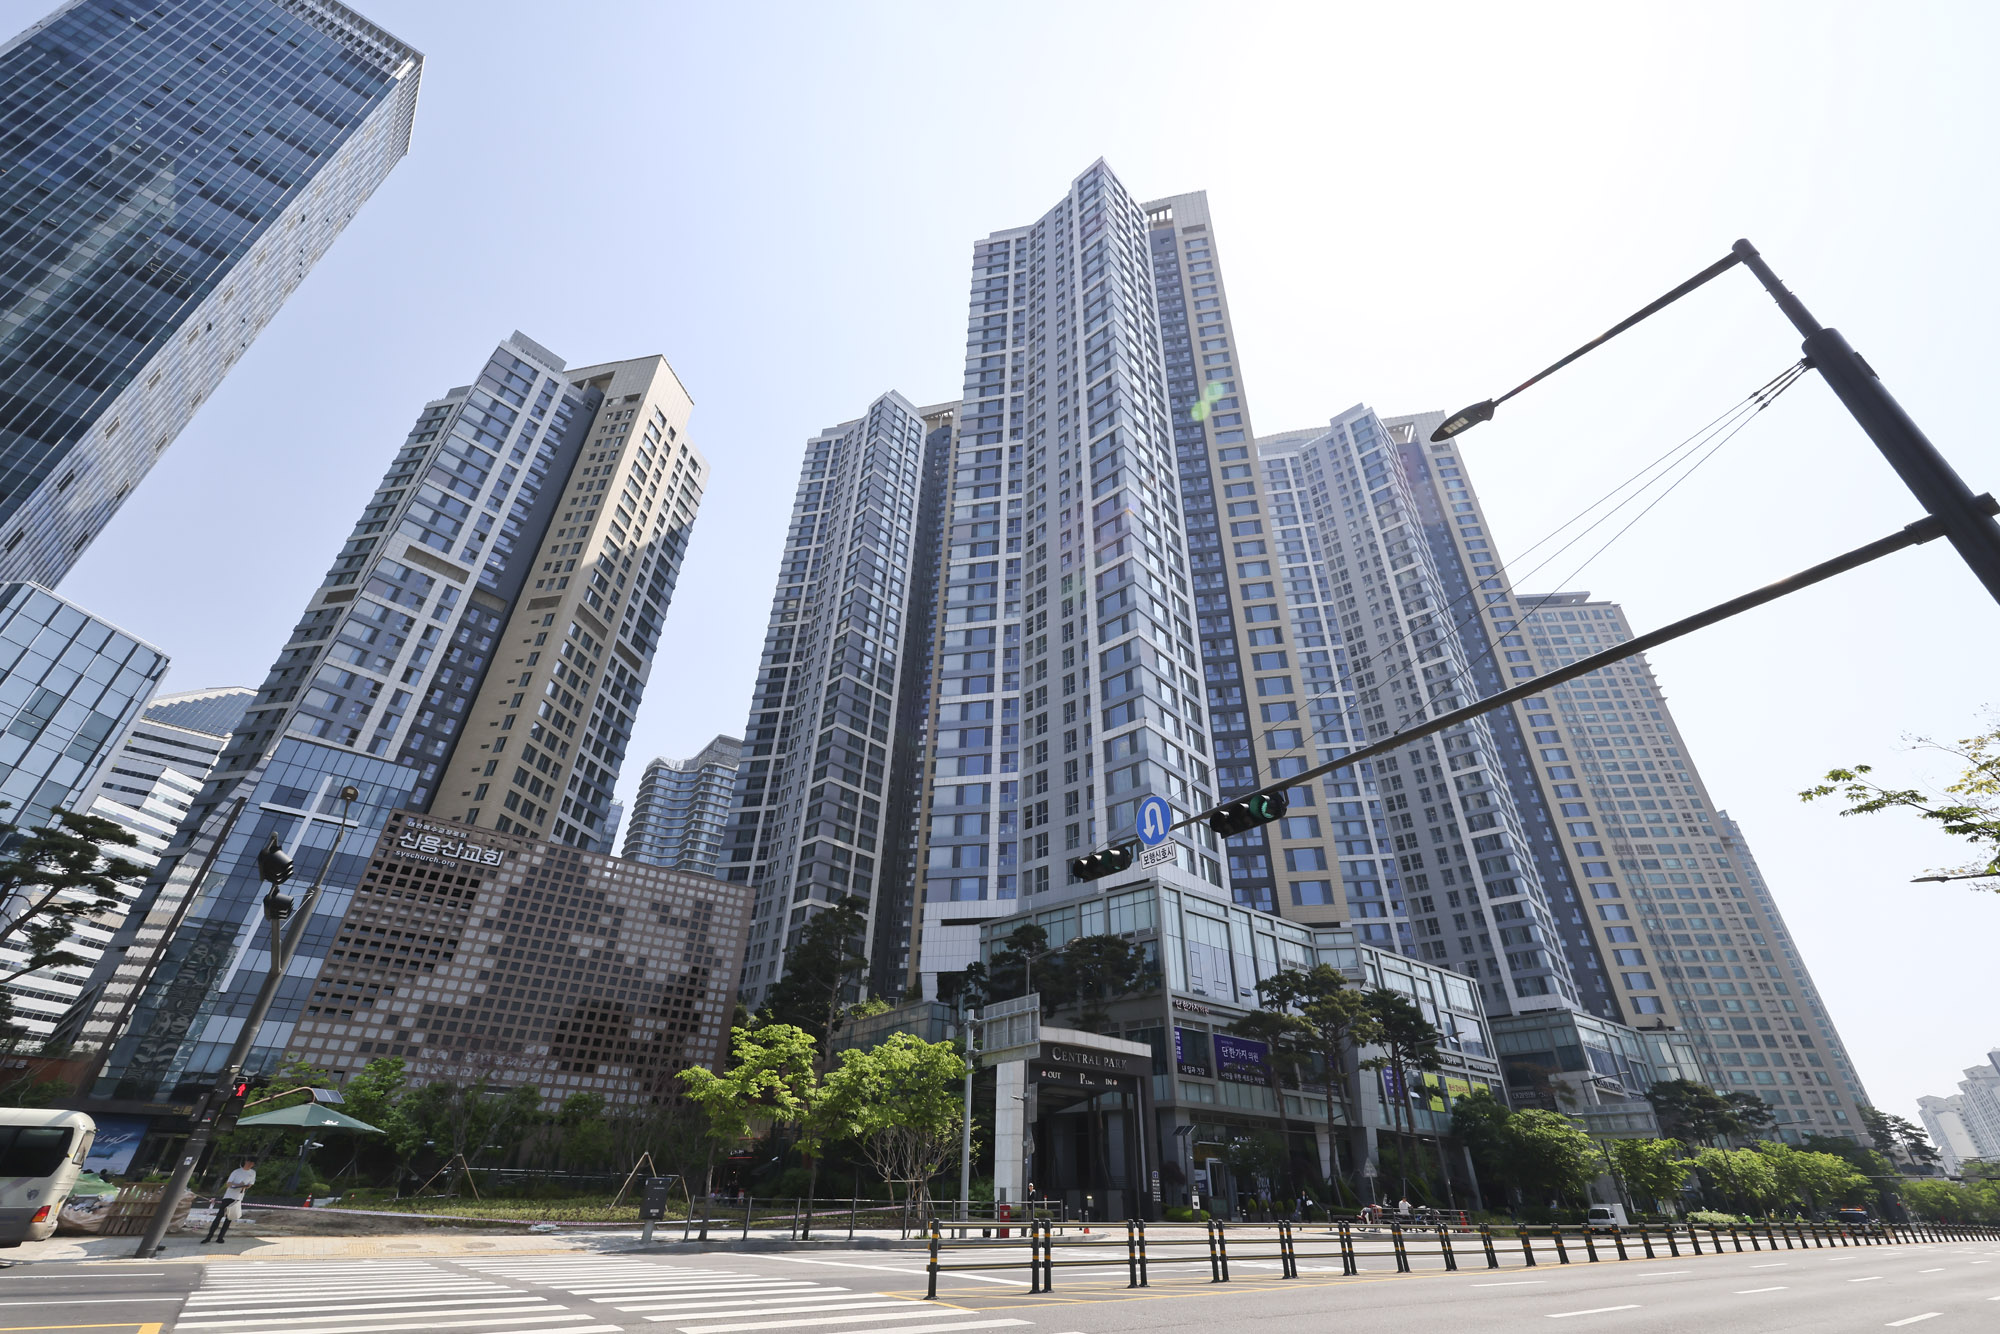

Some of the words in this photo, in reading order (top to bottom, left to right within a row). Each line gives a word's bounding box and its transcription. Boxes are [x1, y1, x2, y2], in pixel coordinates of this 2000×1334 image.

[399, 832, 504, 867] 신용산교회
[1143, 845, 1174, 865] 보행신호시
[395, 850, 456, 867] syschurch.org
[1103, 1057, 1127, 1069] PARK
[1047, 1071, 1061, 1080] OUT
[1105, 1078, 1113, 1086] IN
